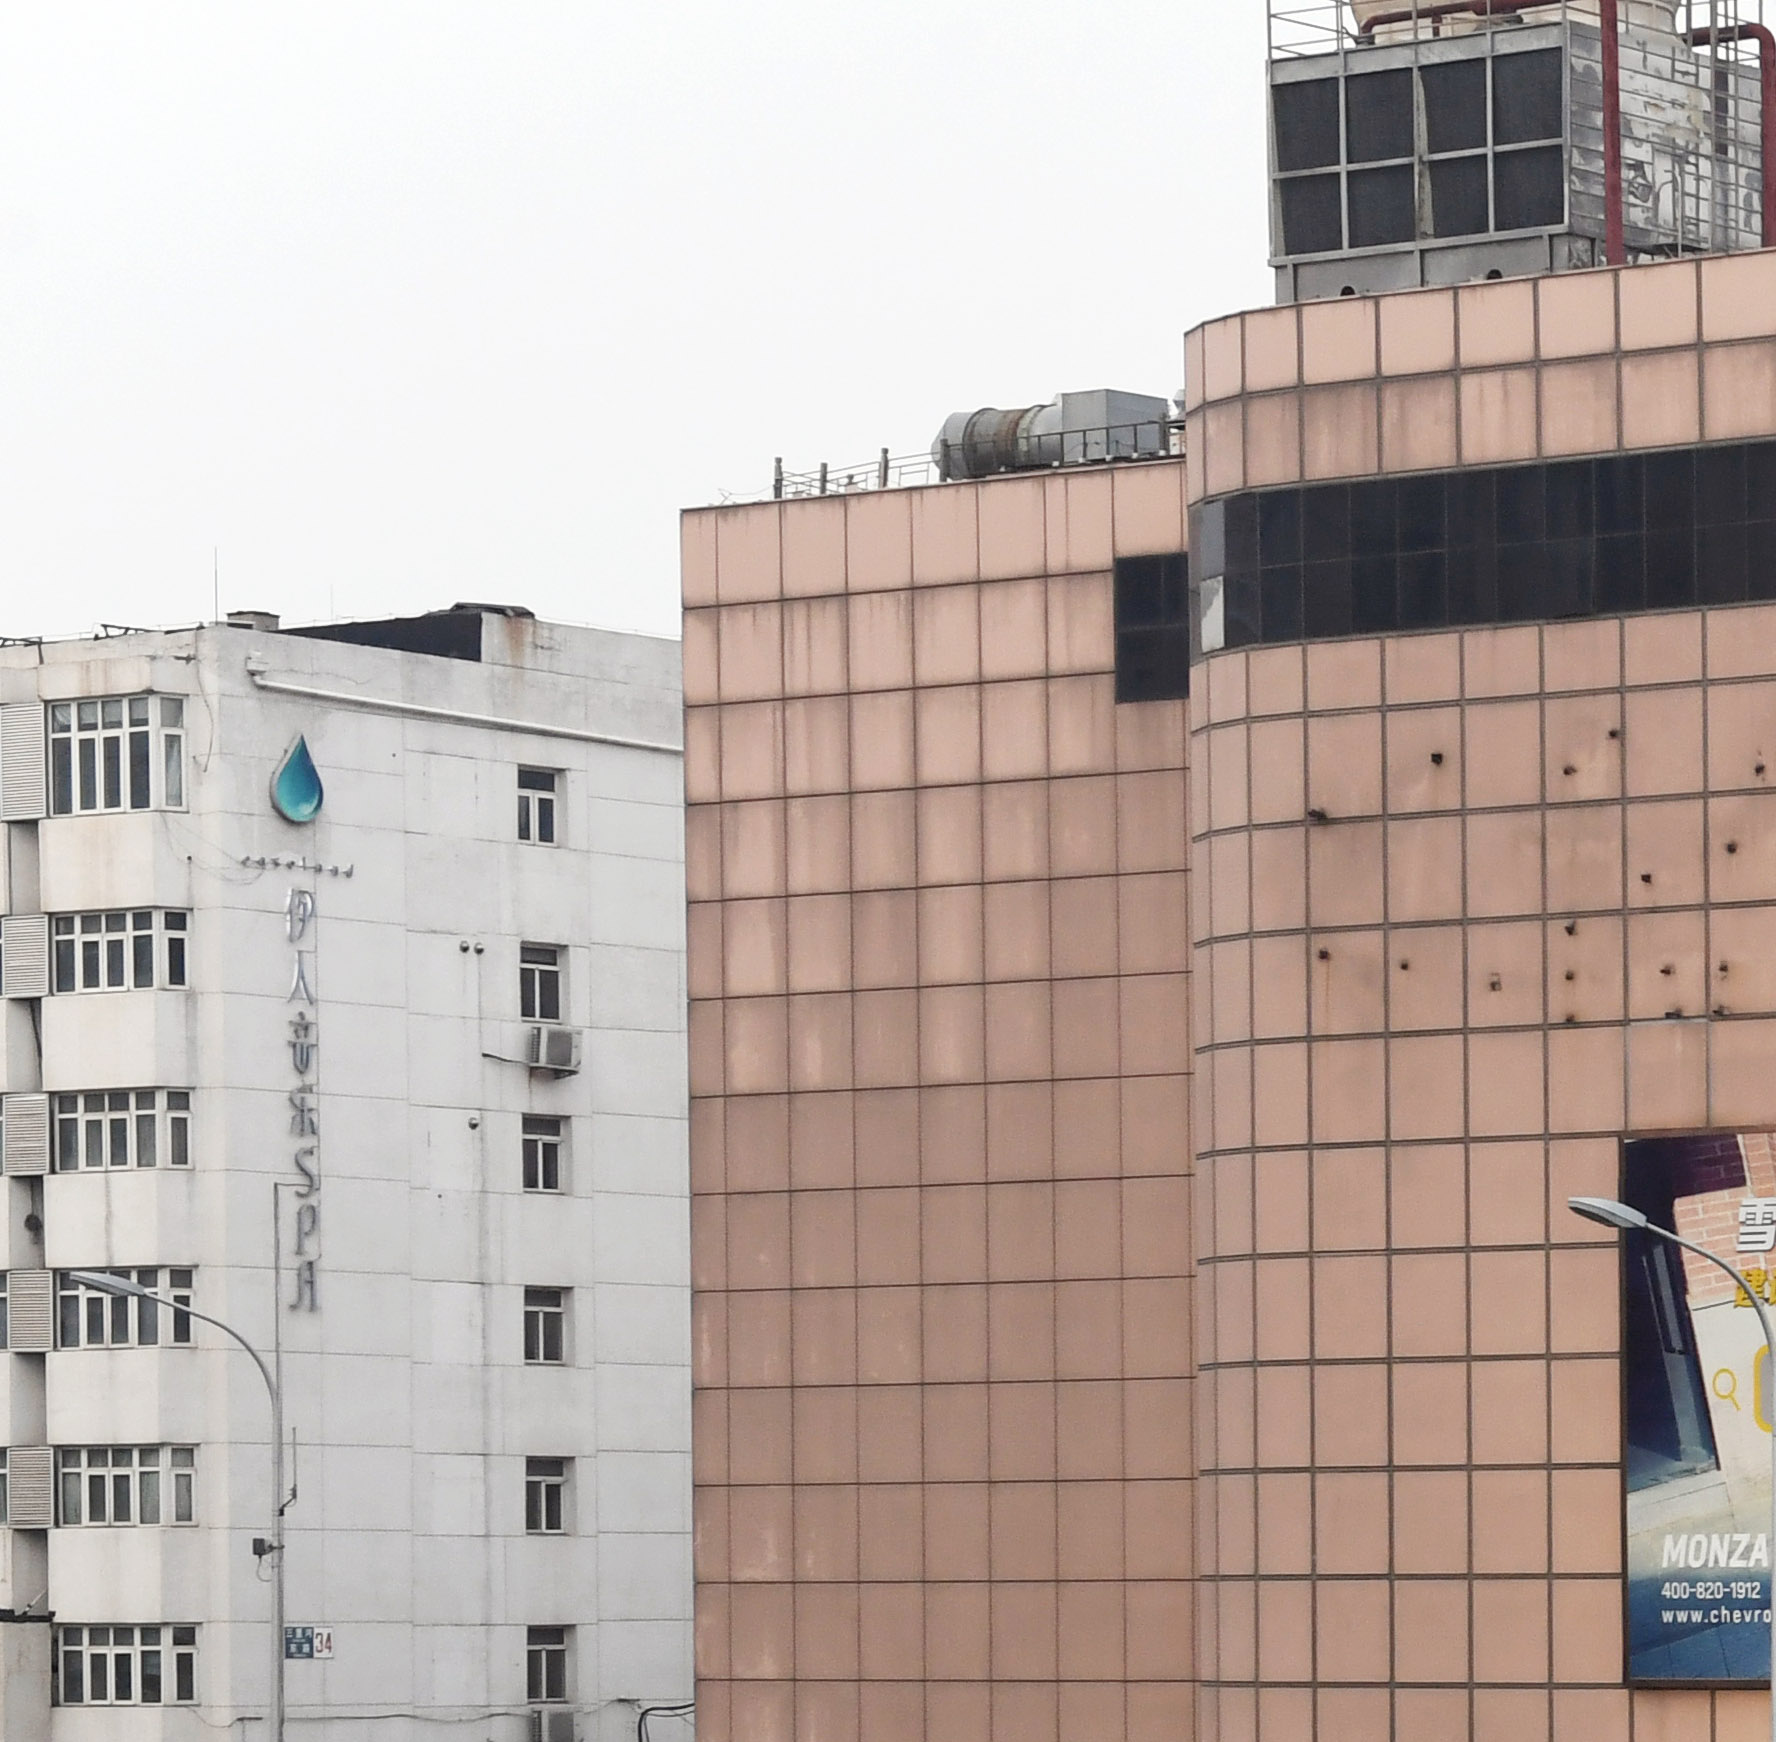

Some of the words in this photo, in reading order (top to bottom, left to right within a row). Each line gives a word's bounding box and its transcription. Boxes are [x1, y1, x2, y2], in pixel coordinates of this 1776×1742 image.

[1661, 1532, 1769, 1569] MONZA
[1661, 1581, 1761, 1599] 400-820-1912
[315, 1632, 332, 1653] 34
